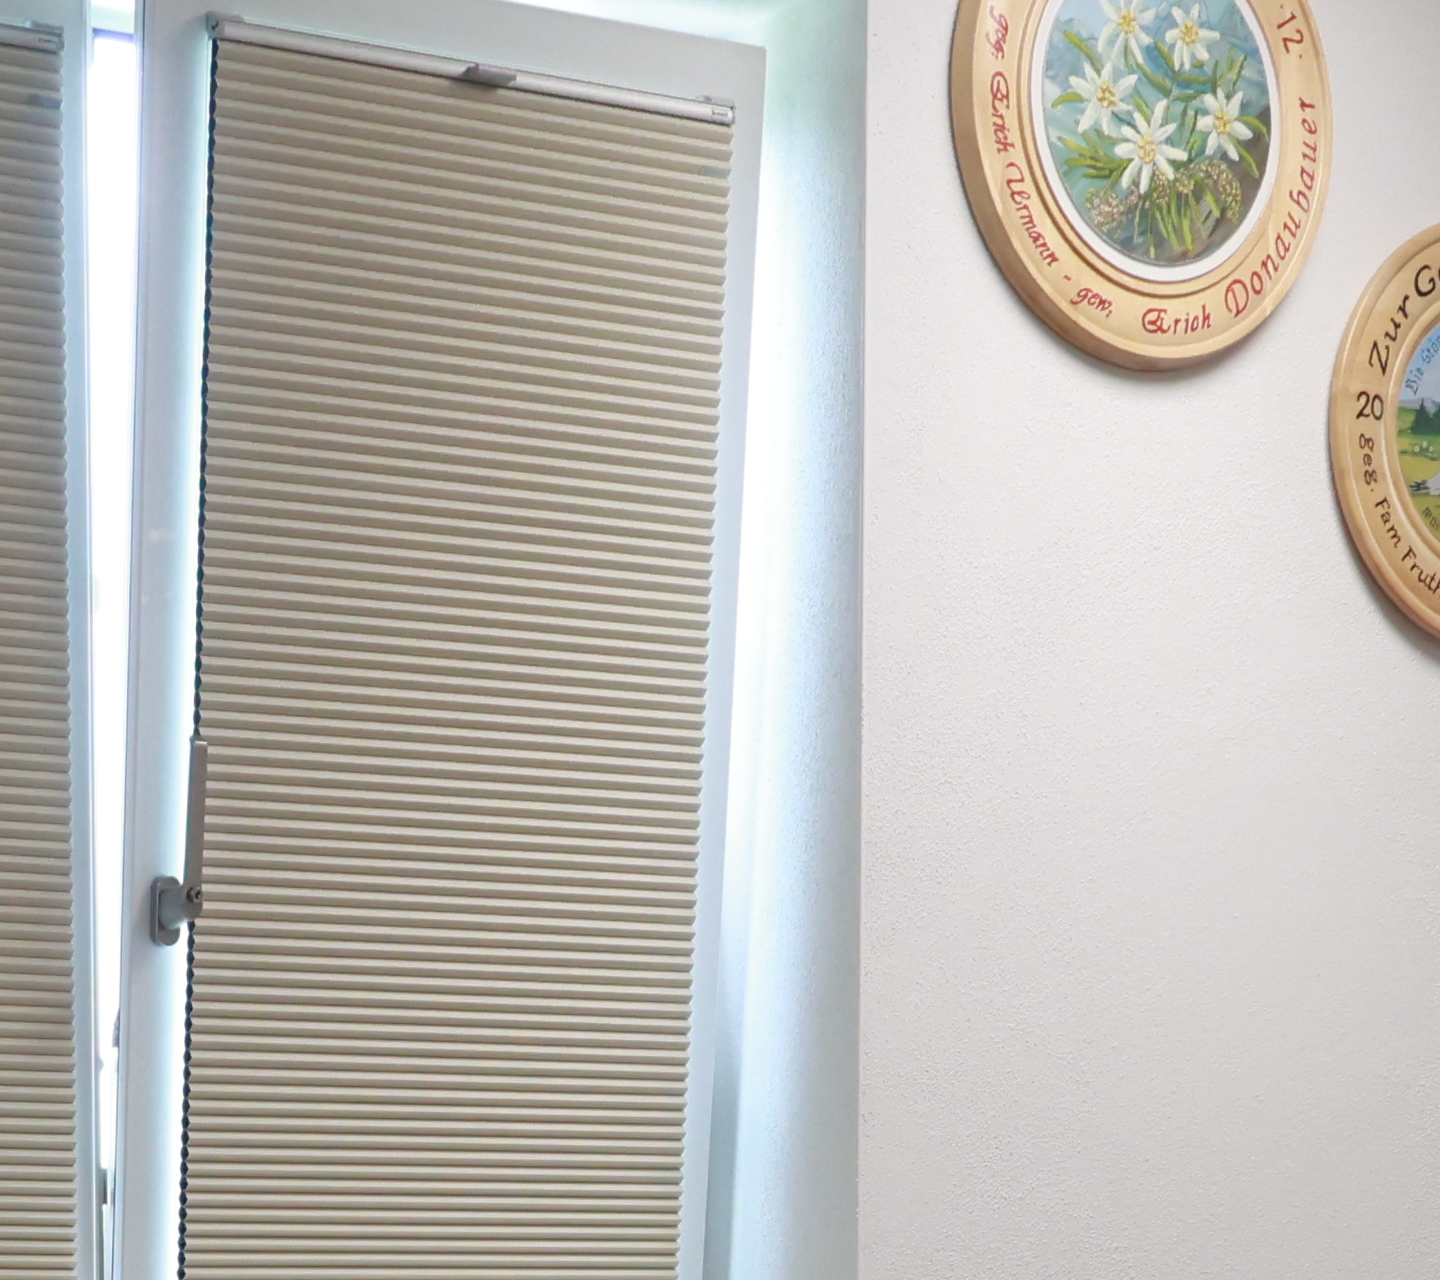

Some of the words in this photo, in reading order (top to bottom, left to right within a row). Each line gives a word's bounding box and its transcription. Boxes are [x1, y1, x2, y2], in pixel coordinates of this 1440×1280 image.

[1141, 304, 1213, 337] Erich
[1222, 97, 1317, 319] Donaubauer
[1367, 293, 1410, 377] Zur
[1355, 390, 1385, 421] 20
[1374, 495, 1402, 548] Fam
